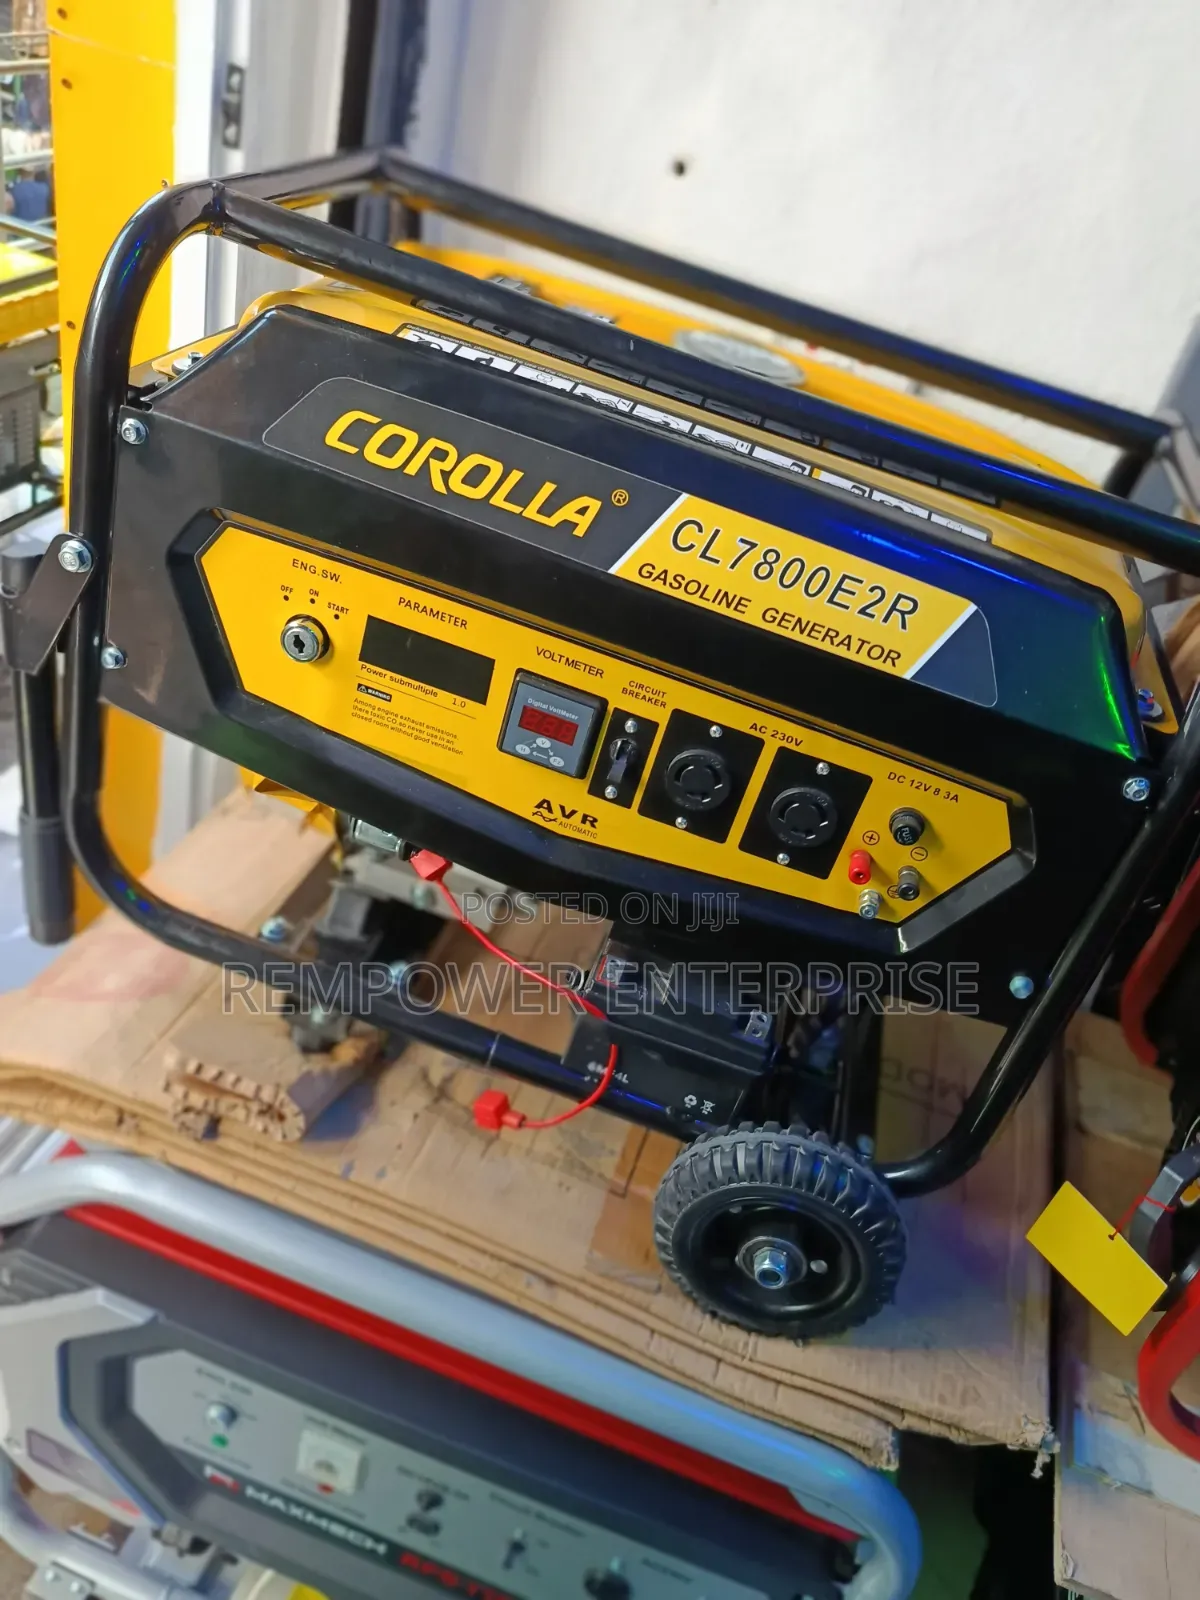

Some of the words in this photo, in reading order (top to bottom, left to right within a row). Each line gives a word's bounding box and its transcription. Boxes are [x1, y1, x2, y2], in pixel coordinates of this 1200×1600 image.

[406, 324, 429, 334] Before
[473, 345, 498, 356] please
[556, 372, 583, 383] manual
[324, 410, 602, 538] COROLLA
[291, 558, 343, 584] ENG.SW.
[670, 518, 921, 632] CL7800E2R
[280, 585, 294, 595] OFF
[308, 588, 320, 598] ON
[327, 602, 350, 615] START
[398, 596, 468, 630] PARAMETER
[636, 562, 752, 615] GASOLINE
[760, 606, 902, 668] GENERATOR
[535, 646, 605, 679] VOLTMETER
[360, 663, 387, 679] Power
[389, 675, 439, 699] submultiple
[452, 697, 467, 709] 1.0
[367, 688, 391, 701] WARNING
[621, 687, 668, 710] BREAKER
[628, 680, 668, 699] CIRCUIT
[354, 698, 376, 710] Among
[377, 706, 399, 718] engine
[399, 715, 425, 727] exhaust
[527, 697, 549, 710] Digital
[548, 705, 579, 720] VoltMeter
[351, 712, 372, 723] closed
[373, 719, 389, 729] room
[390, 726, 413, 738] without
[413, 734, 430, 744] good
[430, 740, 464, 755] ventilation
[352, 705, 369, 715] there
[370, 711, 385, 721] toxic
[407, 725, 426, 735] never
[426, 731, 439, 740] use
[748, 722, 768, 736] AC
[770, 729, 804, 748] 230V
[887, 771, 906, 784] DC
[909, 779, 932, 792] 12V
[534, 798, 599, 829] AVR
[558, 821, 598, 839] AUTOMATIC
